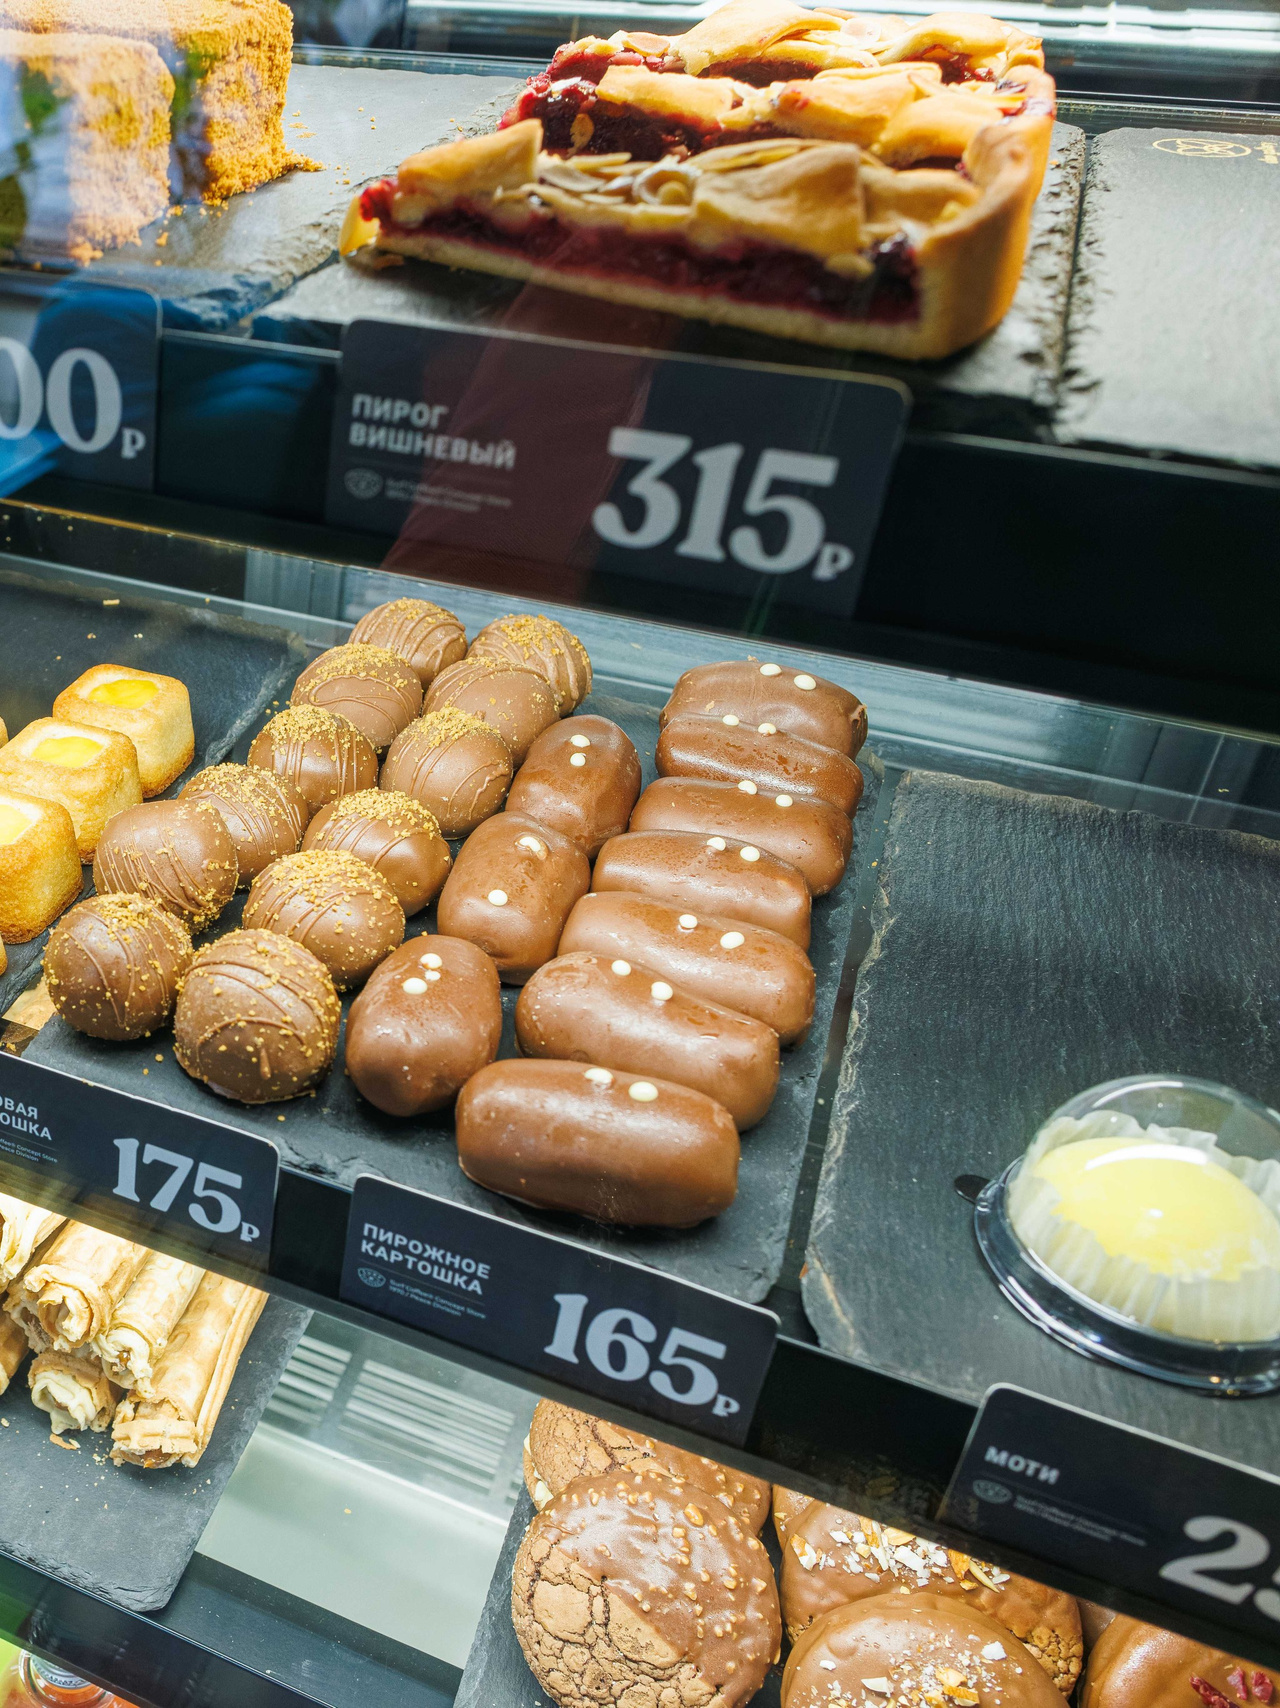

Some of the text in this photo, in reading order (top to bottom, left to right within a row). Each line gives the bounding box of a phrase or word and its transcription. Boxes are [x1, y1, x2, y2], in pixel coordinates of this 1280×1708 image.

[350, 393, 449, 429] ПИРОГ
[349, 422, 516, 471] ВИШНЕВЫЙ
[360, 1240, 483, 1296] КАРТОШКА
[361, 1221, 491, 1281] ПИРОЖНОЕ
[984, 1445, 1060, 1486] МОТИ
